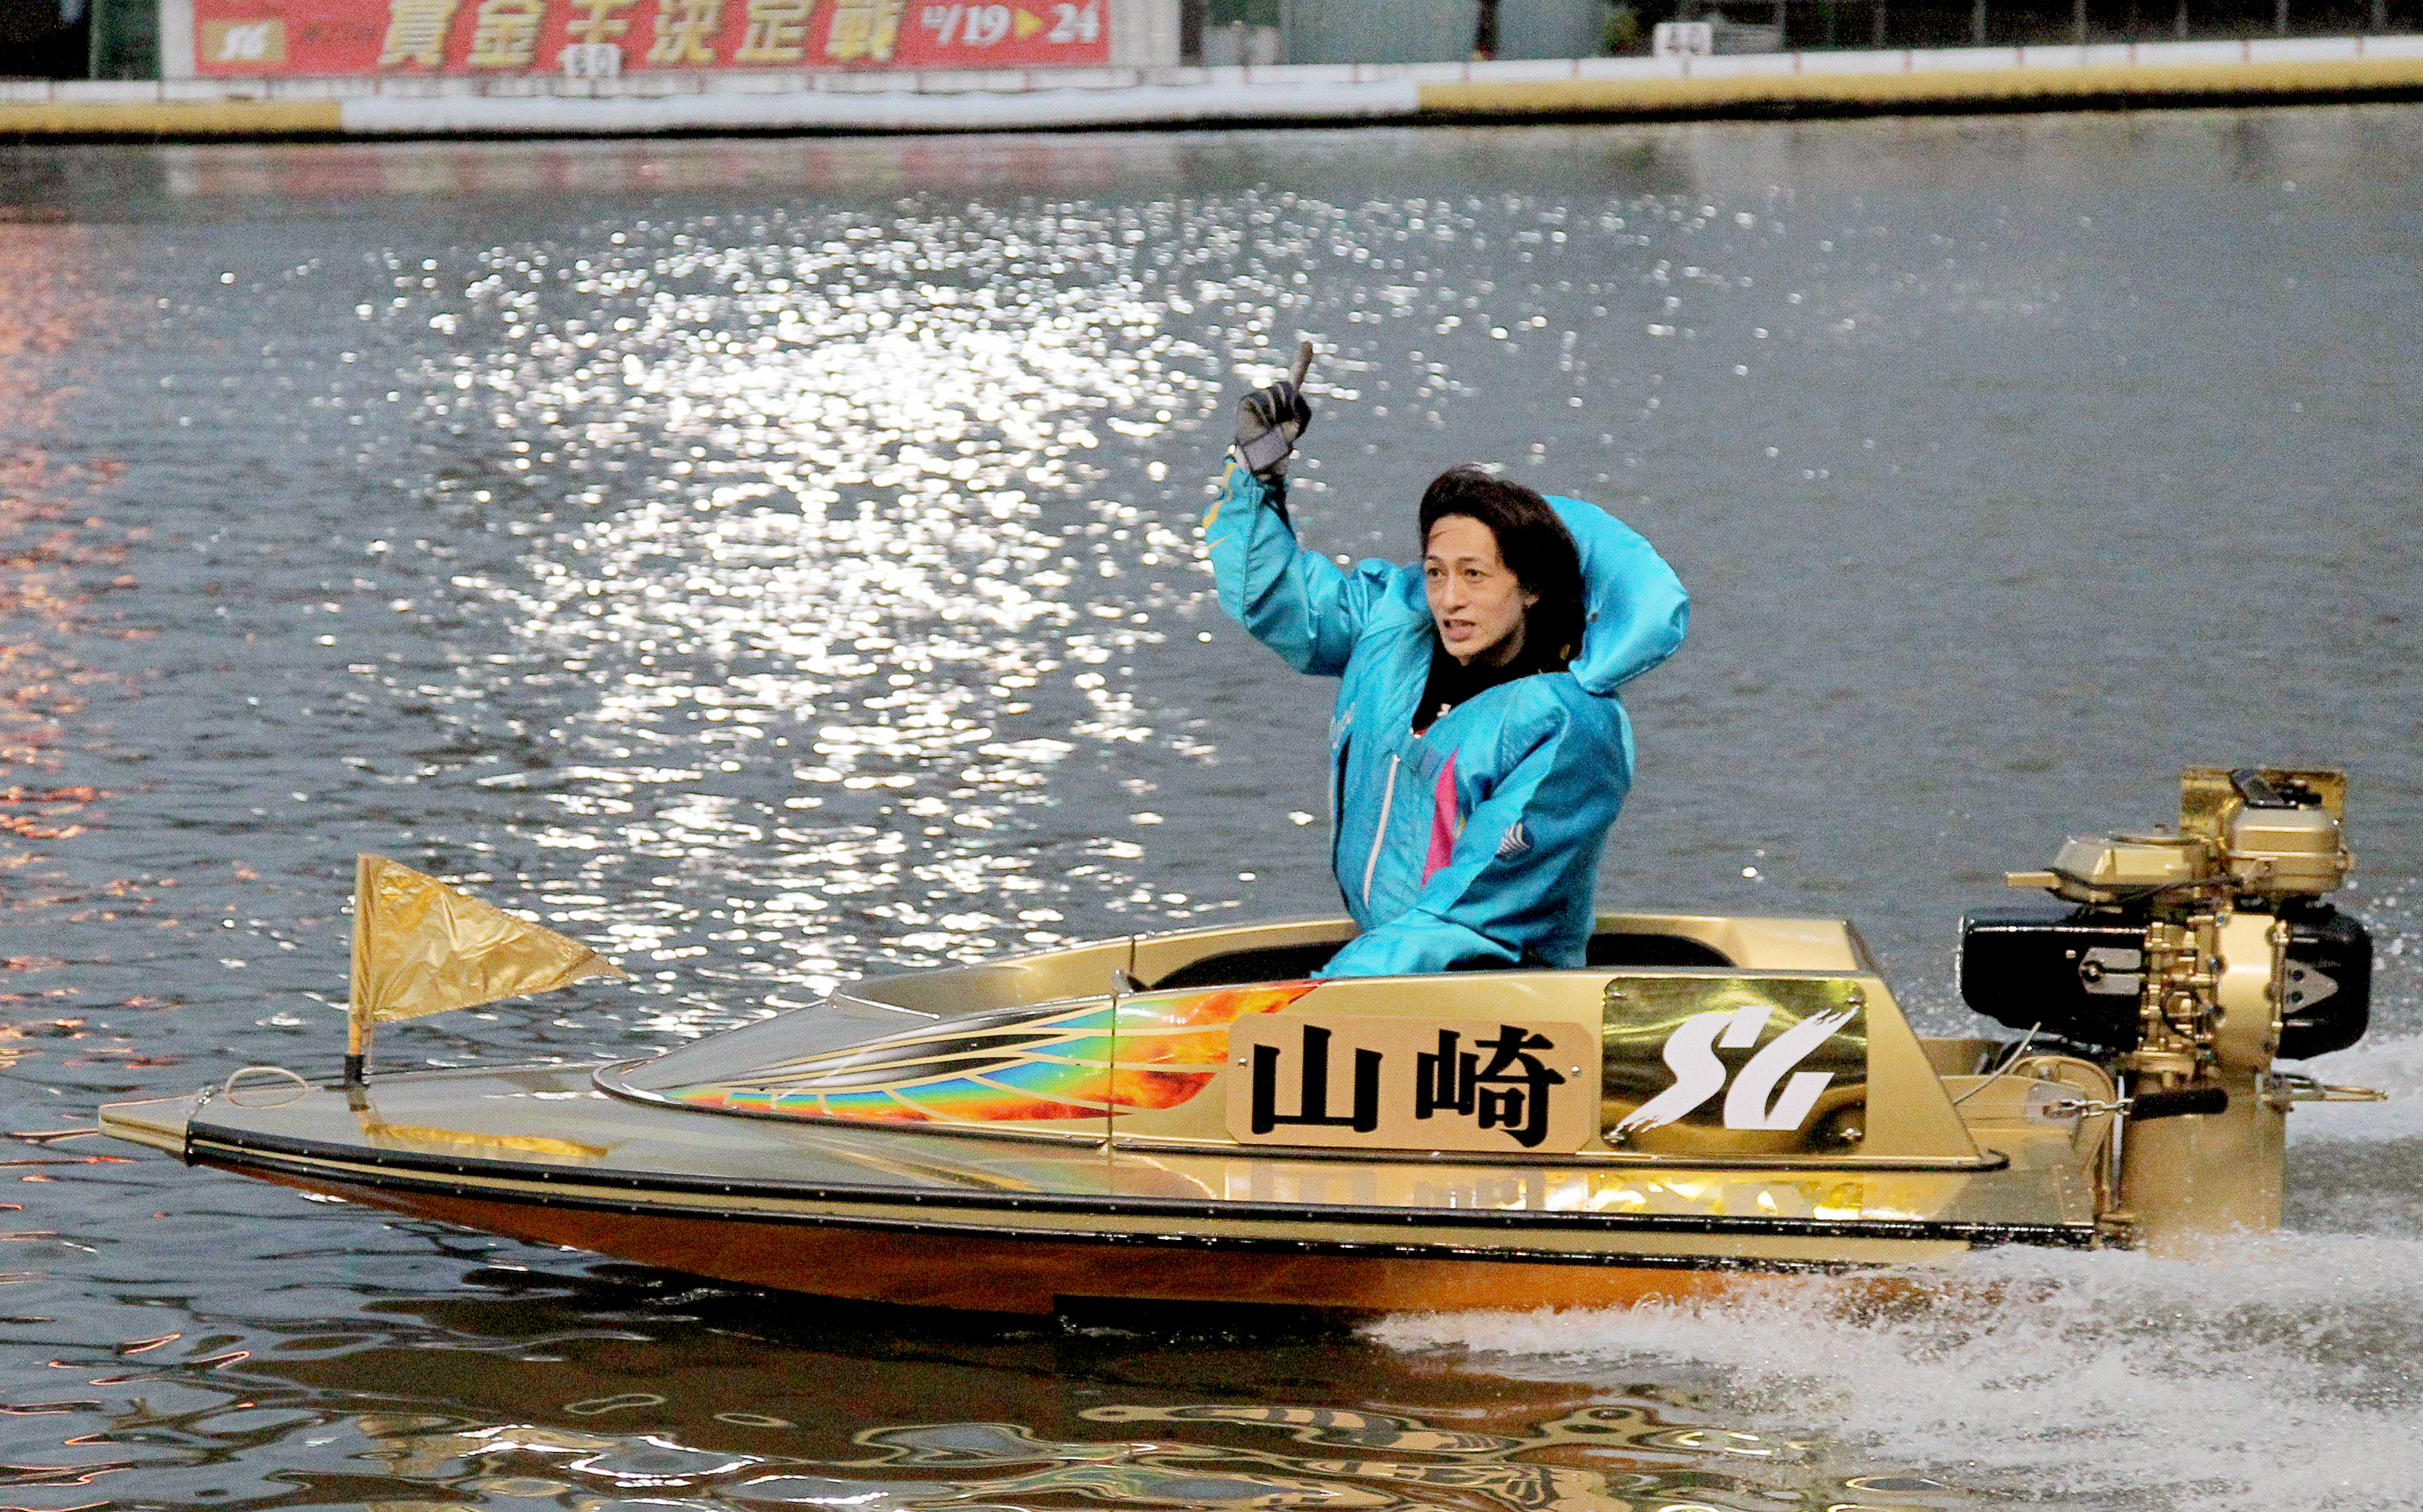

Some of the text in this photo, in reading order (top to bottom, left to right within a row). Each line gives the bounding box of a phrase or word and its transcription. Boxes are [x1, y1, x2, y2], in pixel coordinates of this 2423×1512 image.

[1048, 2, 1099, 44] 24
[1252, 1024, 1566, 1147] 山崎
[1614, 1005, 1860, 1131] SG
